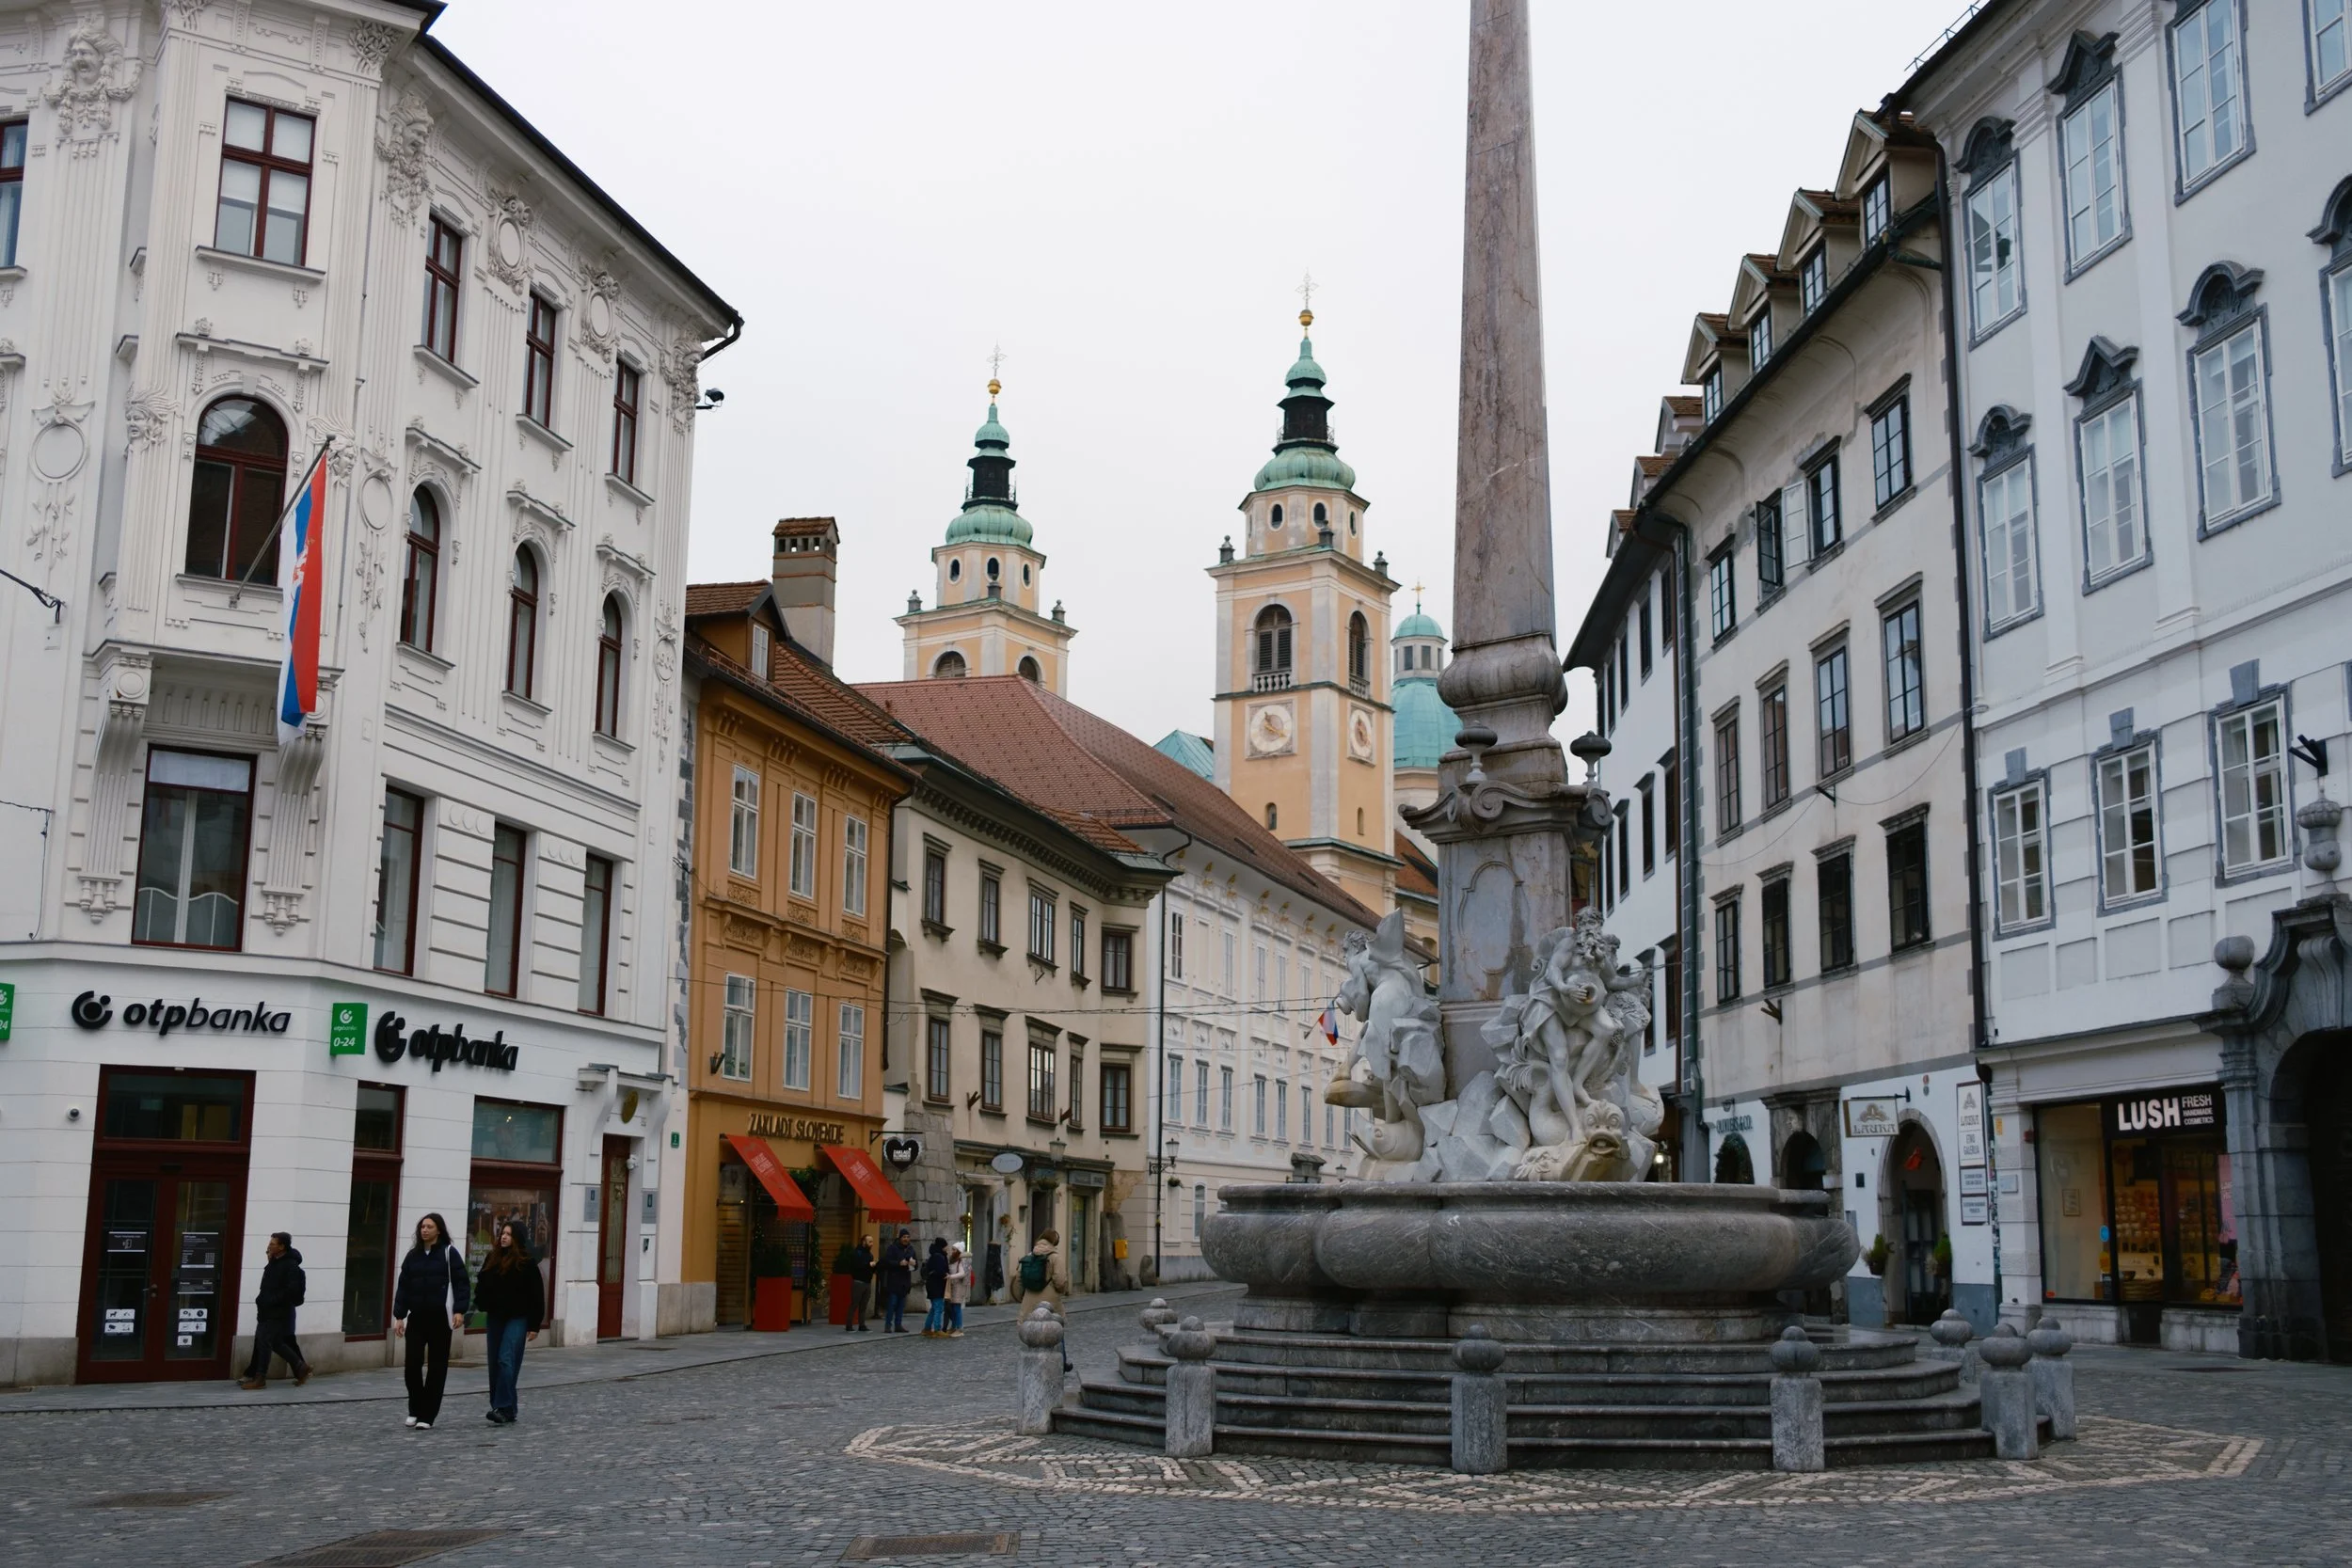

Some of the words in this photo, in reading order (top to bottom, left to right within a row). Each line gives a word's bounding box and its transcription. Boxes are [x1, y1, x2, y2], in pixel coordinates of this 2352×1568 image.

[123, 998, 292, 1037] otpbanka
[333, 1037, 356, 1047] 0-24
[409, 1023, 518, 1072] otpbanka
[2182, 1094, 2212, 1108] FRESH
[2183, 1108, 2213, 1117] HANDMADE
[2118, 1098, 2181, 1131] LUSH
[2184, 1117, 2215, 1125] COSMETICS
[748, 1113, 793, 1138] ZAKLADI
[796, 1119, 845, 1145] SLOVENIJE
